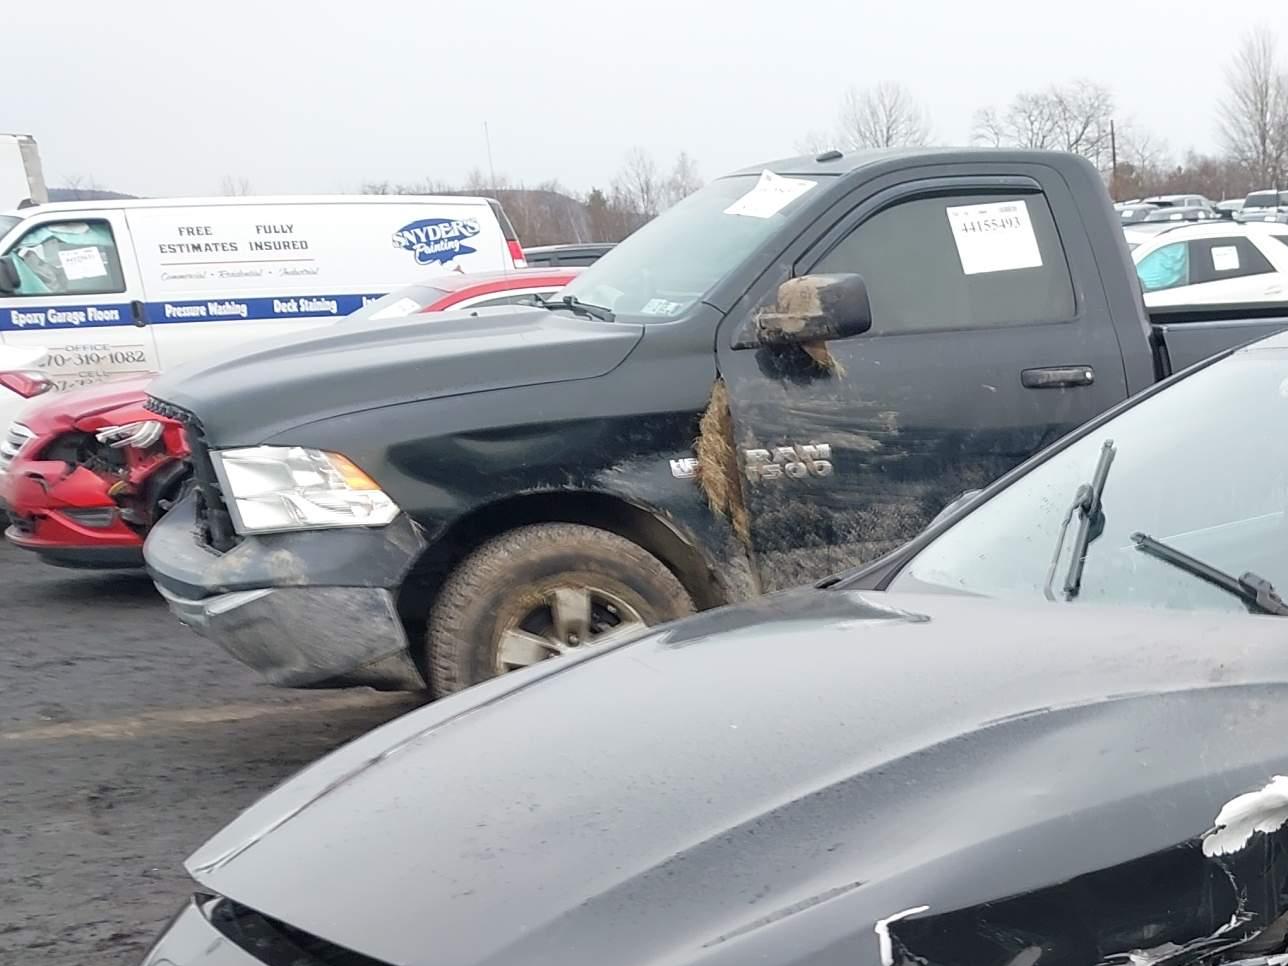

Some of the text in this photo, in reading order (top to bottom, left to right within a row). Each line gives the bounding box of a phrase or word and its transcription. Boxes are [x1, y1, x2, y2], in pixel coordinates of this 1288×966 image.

[178, 226, 213, 236] FREE
[255, 224, 294, 235] FULLY
[159, 242, 239, 254] ESTIMATES
[249, 240, 309, 251] INSURED
[412, 239, 460, 265] Painting
[165, 301, 248, 318] Pressure Washing
[273, 298, 338, 313] Deck Staining
[10, 306, 120, 327] Epoxy Garage Floors
[64, 344, 111, 352] OFFICE
